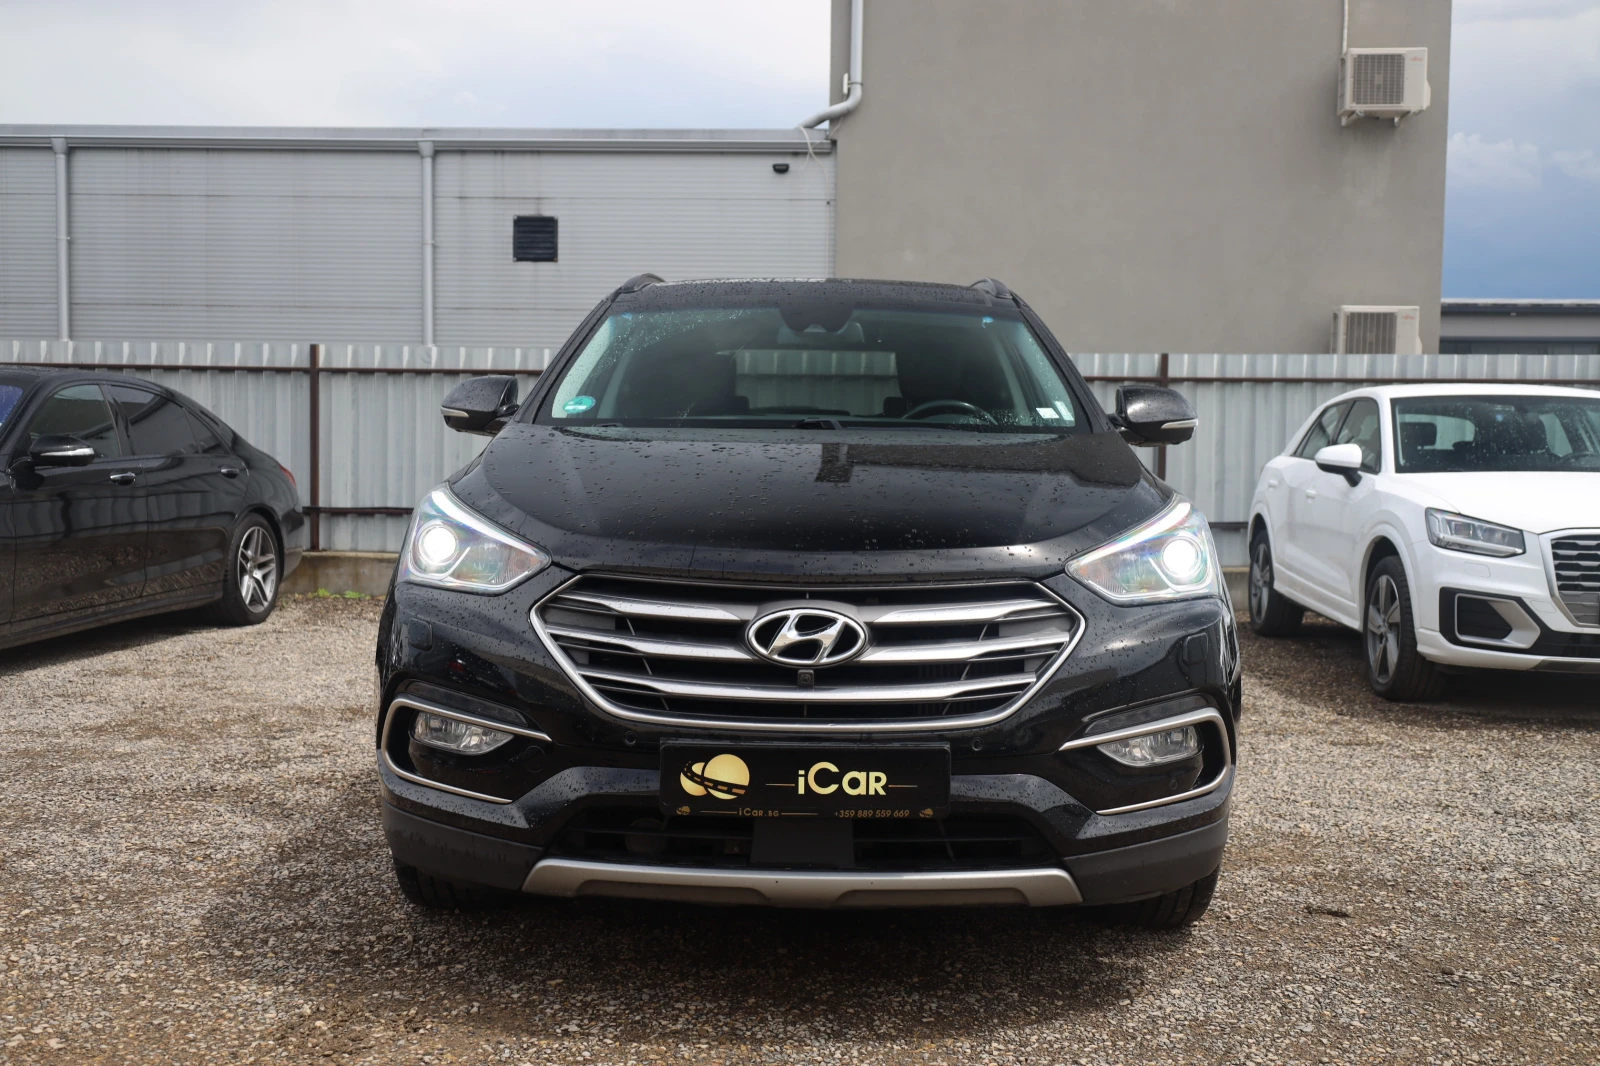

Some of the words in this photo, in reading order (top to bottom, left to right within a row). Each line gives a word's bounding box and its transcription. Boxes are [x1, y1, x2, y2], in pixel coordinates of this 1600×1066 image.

[834, 809, 856, 818] +359
[856, 809, 874, 818] 889
[875, 809, 892, 818] 559
[893, 809, 910, 818] 669
